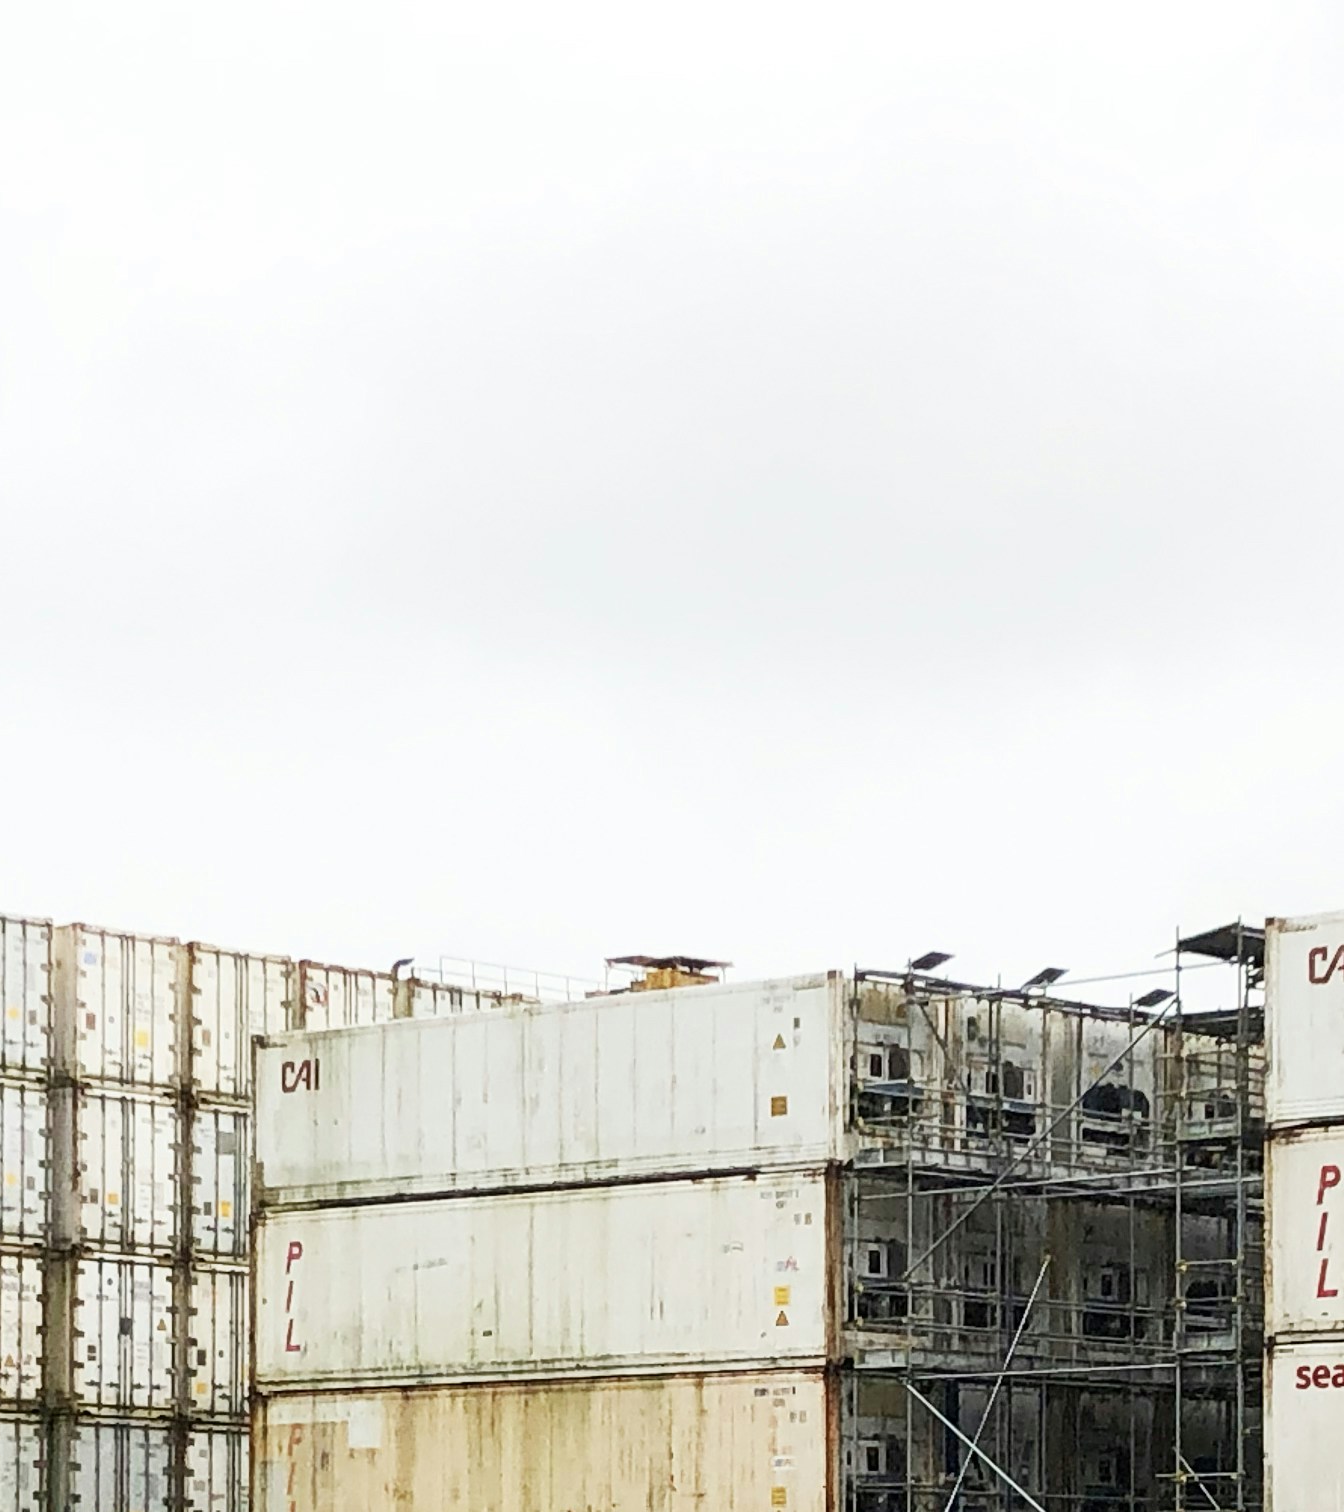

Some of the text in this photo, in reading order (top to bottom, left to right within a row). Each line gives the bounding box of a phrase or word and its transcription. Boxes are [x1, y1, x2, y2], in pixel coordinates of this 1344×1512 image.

[281, 1058, 320, 1094] CAI
[1315, 1164, 1342, 1298] PIL
[284, 1241, 303, 1353] PIL
